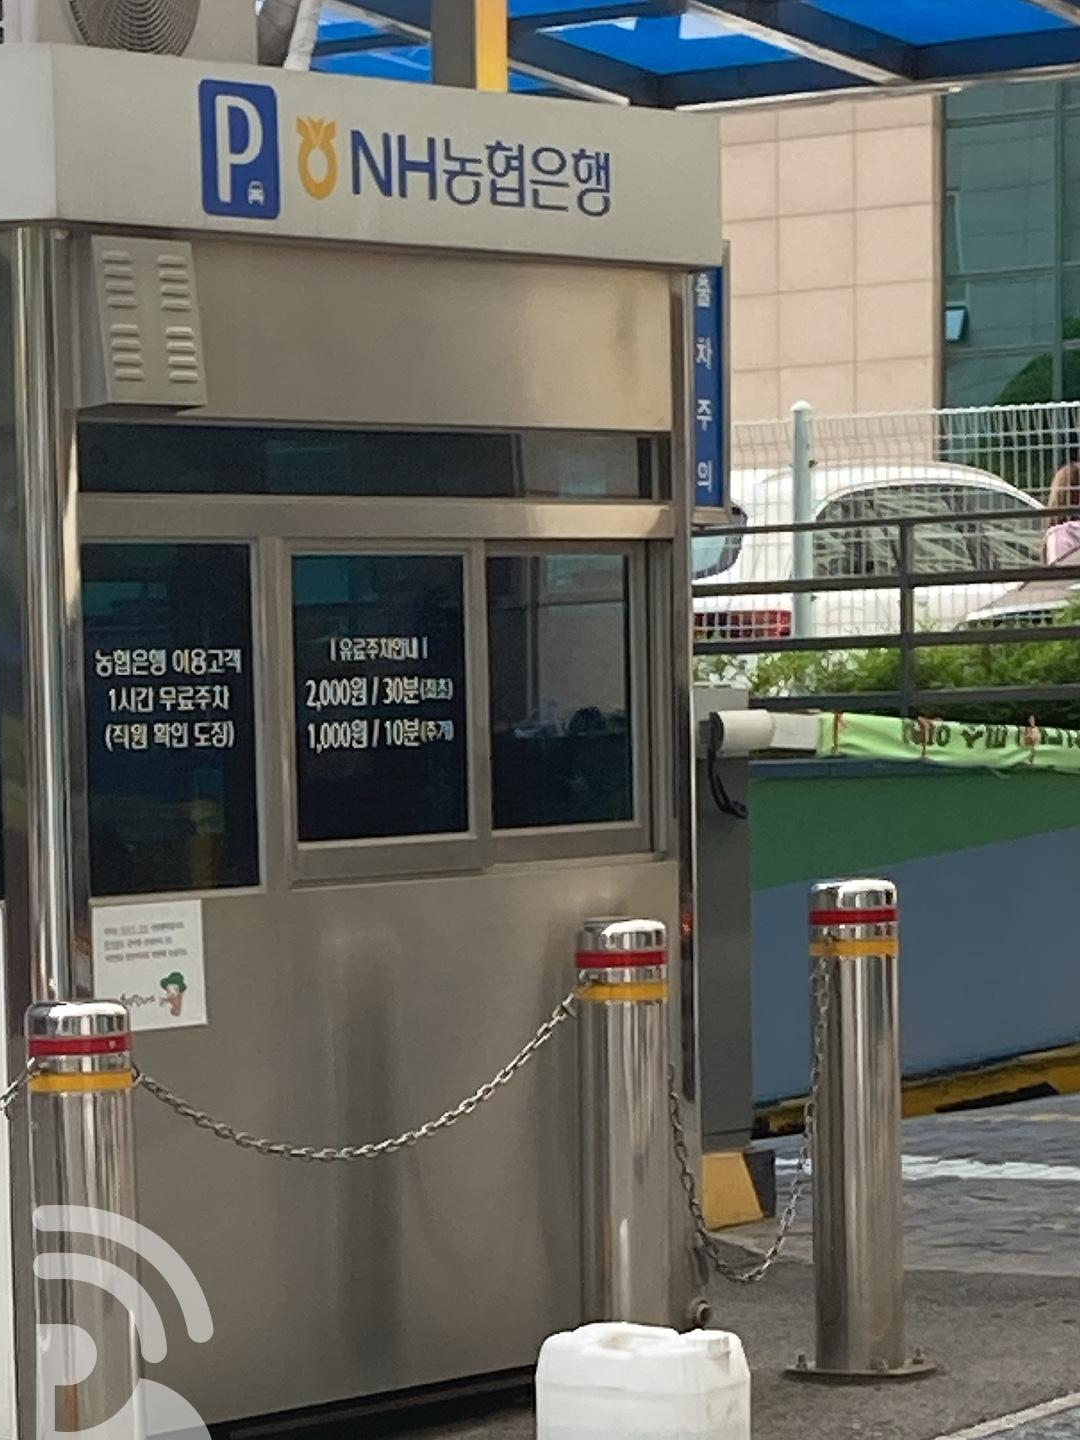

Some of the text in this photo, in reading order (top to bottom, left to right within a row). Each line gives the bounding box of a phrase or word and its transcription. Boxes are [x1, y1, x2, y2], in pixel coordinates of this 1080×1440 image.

[350, 129, 611, 217] NH농협은행
[95, 648, 242, 677] 농협은행 이용고객
[109, 685, 230, 713] 1시간 무료주차
[305, 676, 367, 711] 2,000원
[105, 721, 235, 752] (직원 확인 도장)
[307, 718, 368, 754] 1,000원
